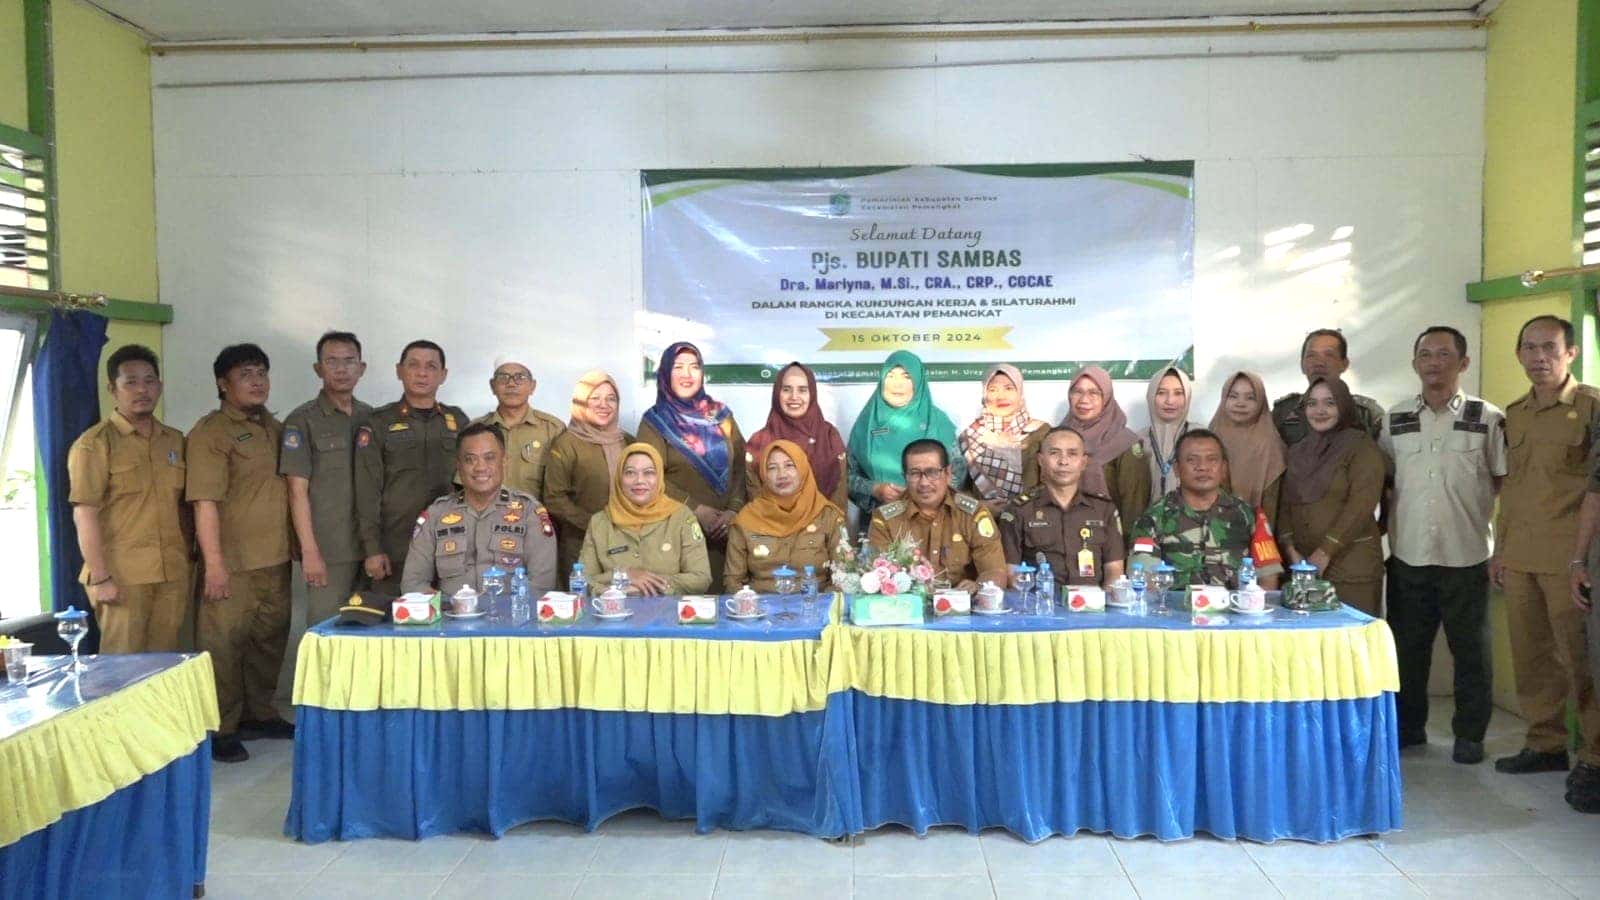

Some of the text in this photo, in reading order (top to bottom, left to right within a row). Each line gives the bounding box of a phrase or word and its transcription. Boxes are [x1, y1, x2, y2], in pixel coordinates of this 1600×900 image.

[850, 222, 982, 248] Selamat Datang
[811, 250, 1022, 275] Pjs. BUPATI SAMBAS
[880, 277, 920, 290] M.Si.,
[1008, 275, 1054, 288] CGCAE
[751, 301, 797, 309] DALAM
[799, 301, 852, 309] RANGKA
[855, 300, 933, 308] KUNJUNGAN
[936, 299, 977, 307] KERJA
[991, 298, 1076, 306] SILATURAHMI
[825, 309, 1002, 319] DI KECAMATAN PEMANGKAT
[852, 333, 981, 343] 15 OKTOBER 2024
